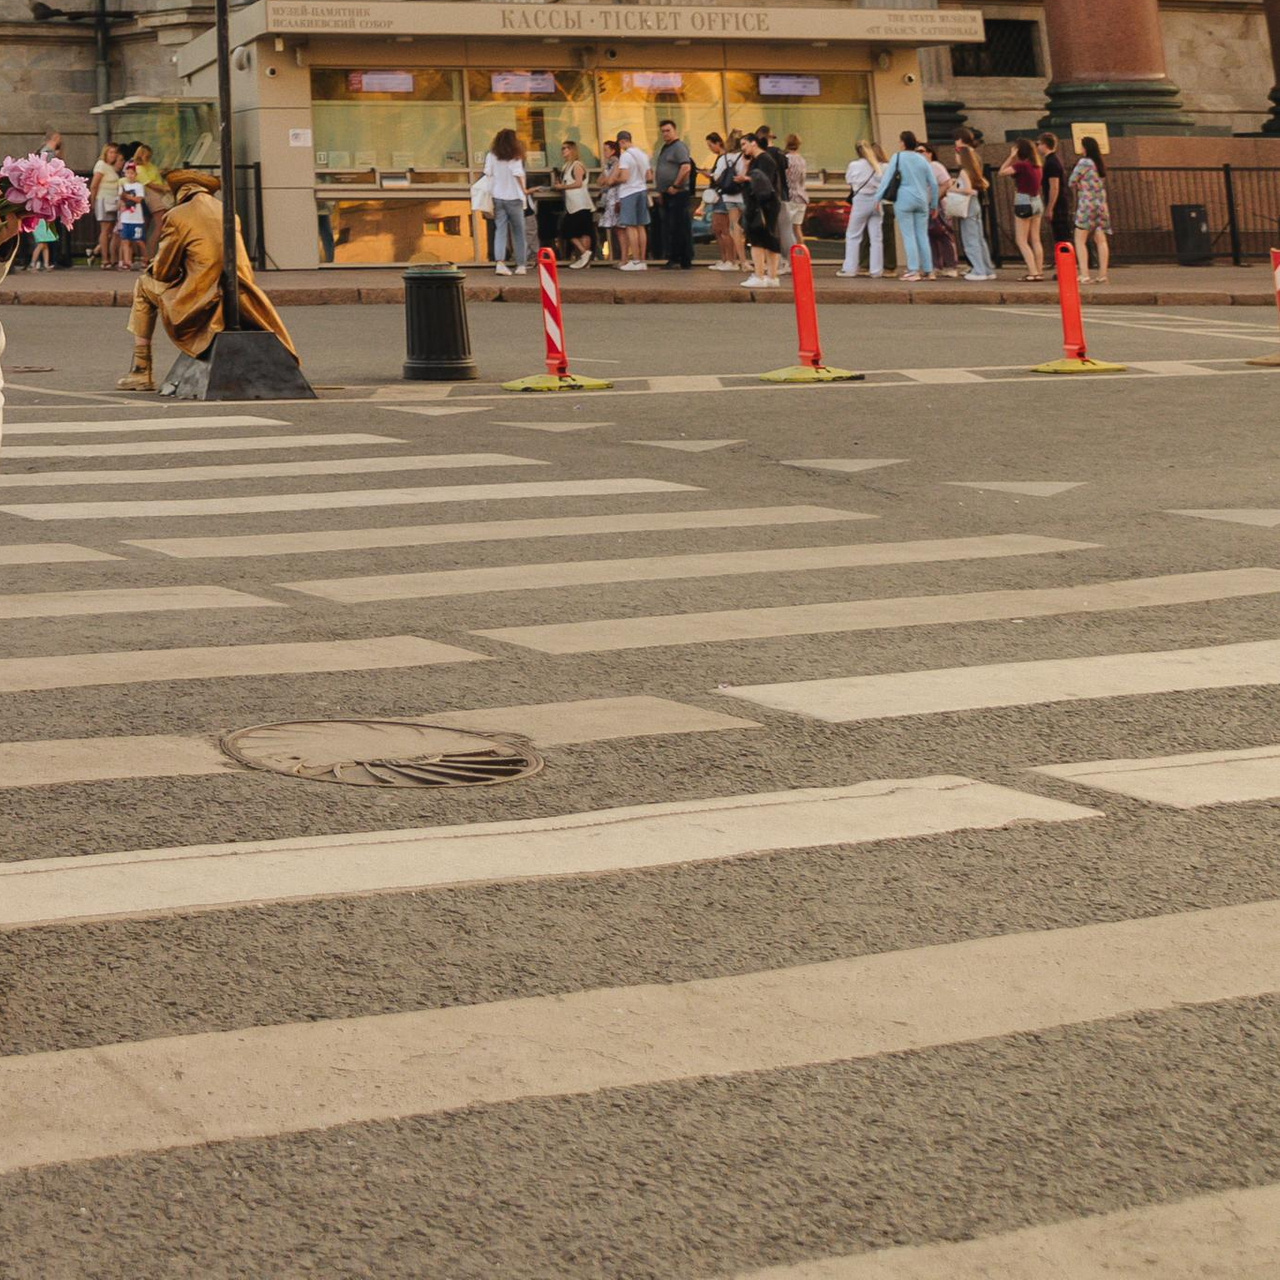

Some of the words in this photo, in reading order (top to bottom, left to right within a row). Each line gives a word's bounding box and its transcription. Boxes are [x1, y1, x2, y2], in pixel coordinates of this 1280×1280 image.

[359, 19, 394, 30] СОБОР
[501, 9, 582, 30] КАССЫ
[599, 10, 681, 31] TICKET
[691, 12, 770, 32] OFFICE
